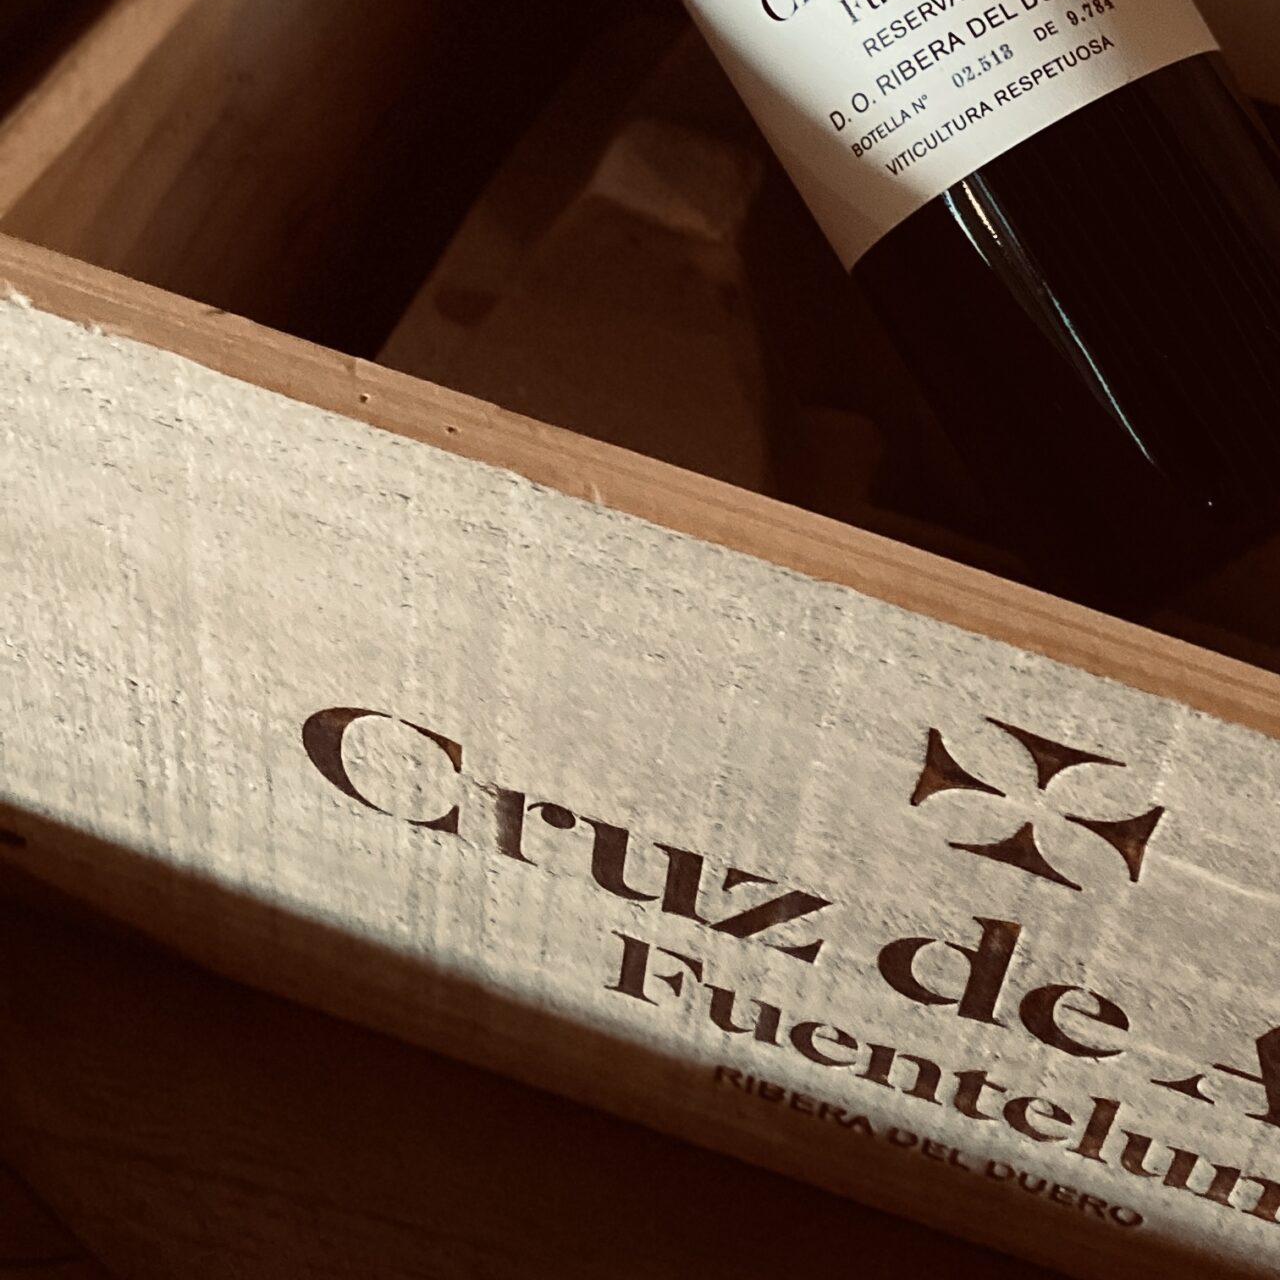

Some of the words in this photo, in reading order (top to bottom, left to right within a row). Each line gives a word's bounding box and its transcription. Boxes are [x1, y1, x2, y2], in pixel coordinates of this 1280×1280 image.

[829, 110, 852, 132] D.
[851, 92, 877, 113] O.
[875, 31, 966, 97] RIBERA
[965, 3, 1019, 39] DEL
[850, 109, 912, 158] BOTELLA
[1033, 21, 1059, 42] DE
[885, 100, 994, 176] VITICULTURA
[993, 34, 1115, 107] RESPETUOSA
[301, 706, 834, 964] Cruz
[876, 916, 1131, 1062] de
[713, 1064, 876, 1139] RIBERA
[887, 1127, 973, 1173] DEL
[985, 1158, 1145, 1228] DUERO
